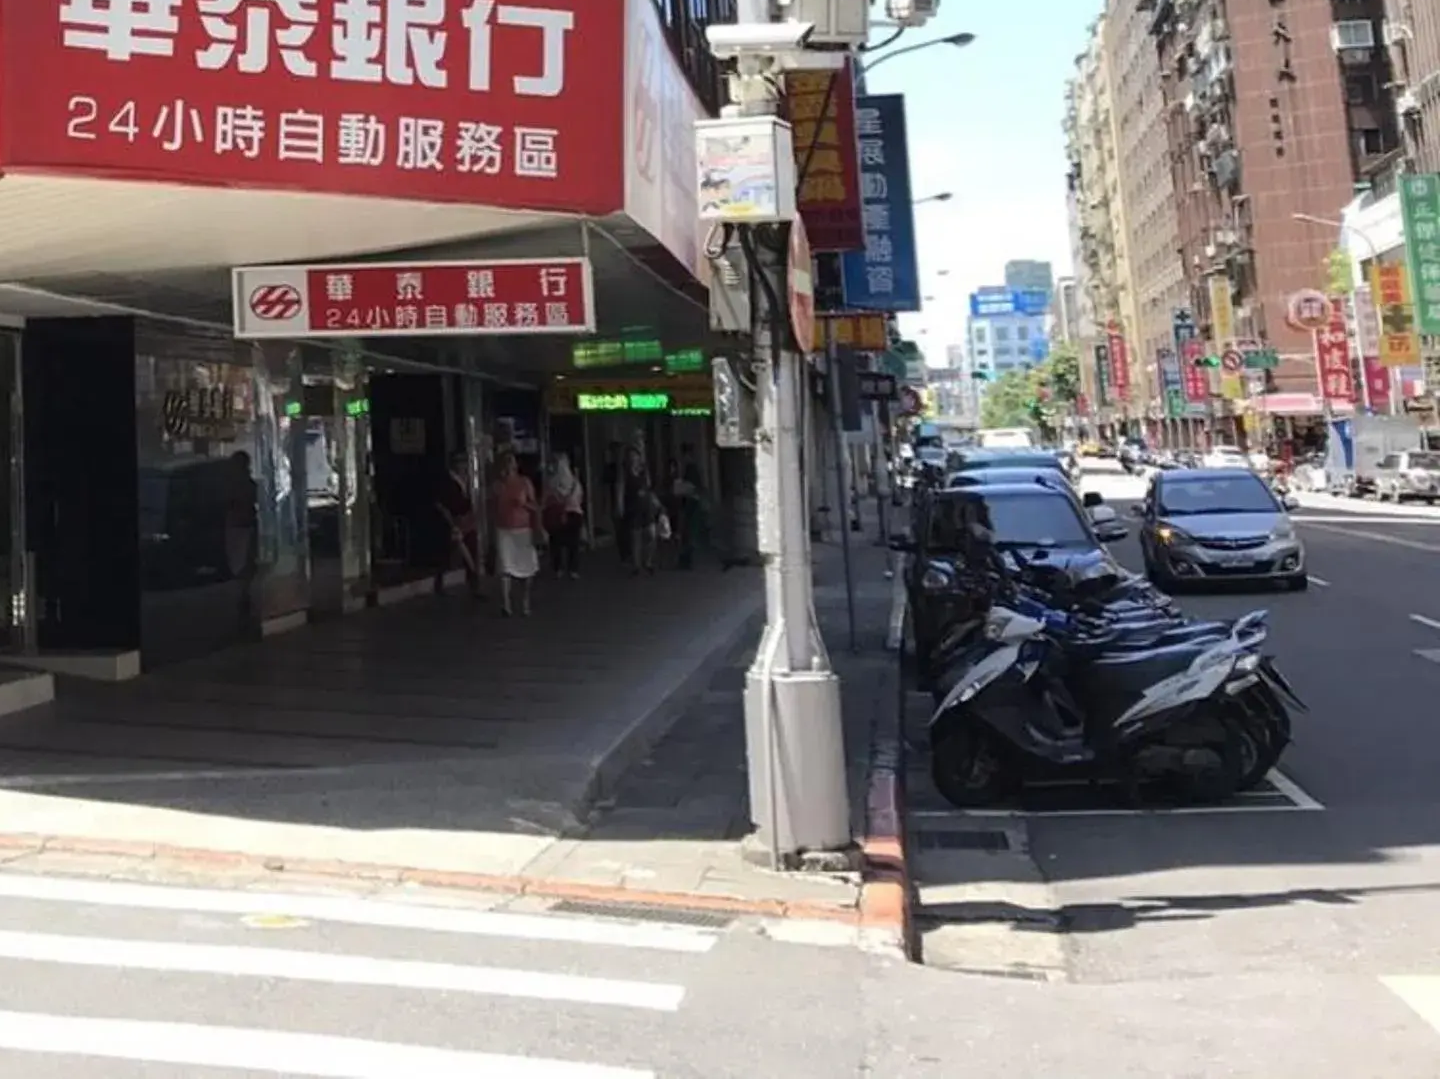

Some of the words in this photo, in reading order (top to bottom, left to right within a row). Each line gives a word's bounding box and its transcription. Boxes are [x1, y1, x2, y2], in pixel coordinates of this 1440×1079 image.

[68, 96, 559, 178] 24小時自動服務區
[325, 268, 567, 302] 華泰銀行
